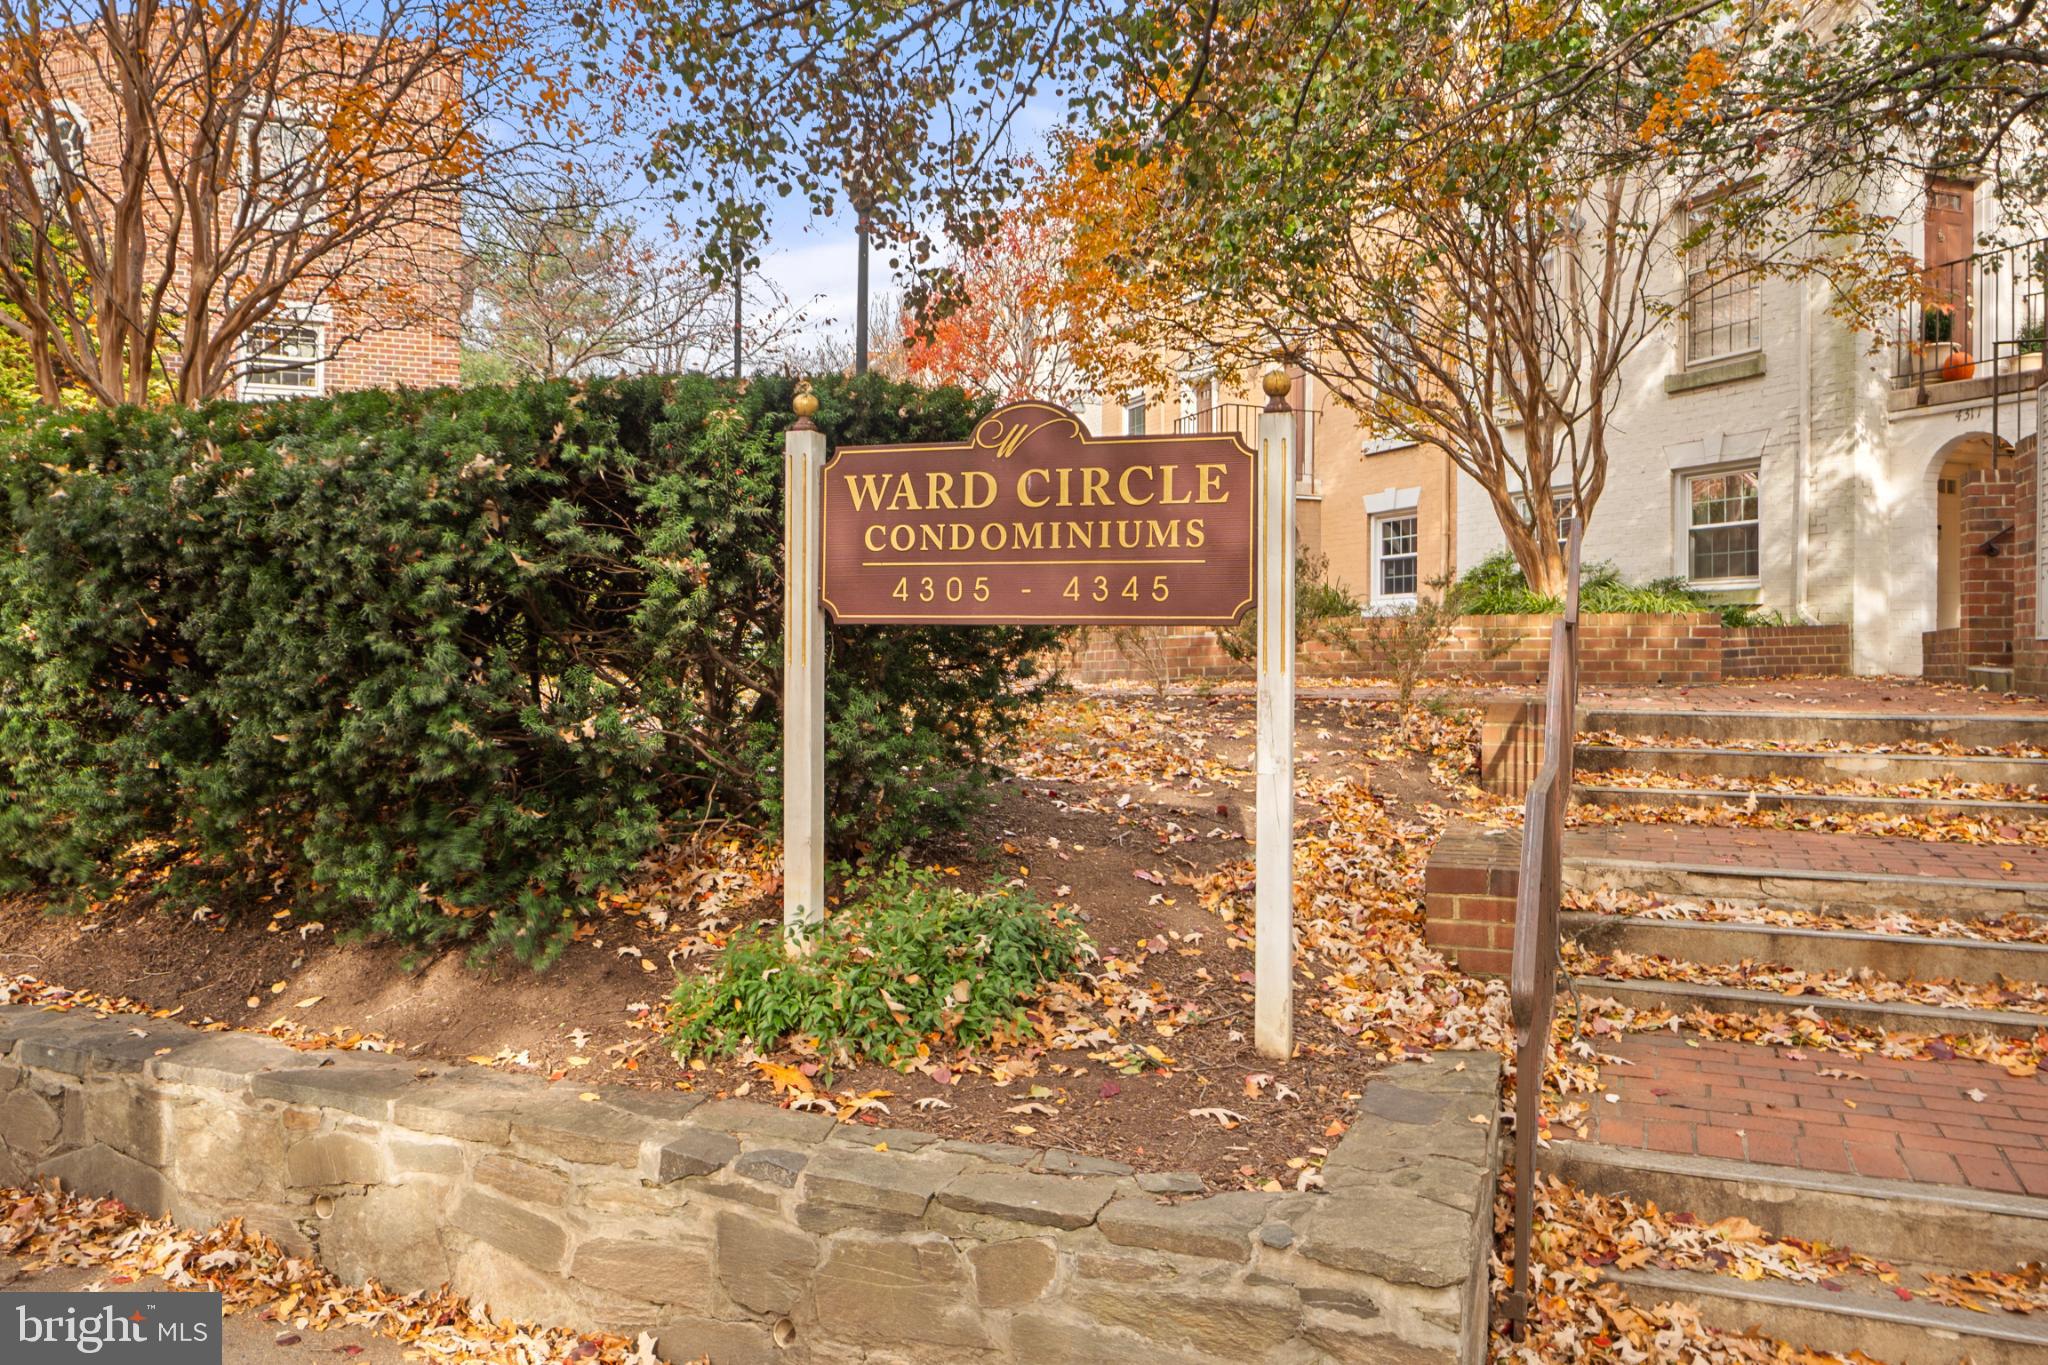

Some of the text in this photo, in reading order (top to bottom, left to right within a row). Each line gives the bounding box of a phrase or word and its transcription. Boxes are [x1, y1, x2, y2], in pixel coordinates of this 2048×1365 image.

[844, 463, 1230, 511] WARD CIRCLE
[864, 519, 1205, 552] CONDOMINIUMS
[892, 577, 990, 601] 4305
[1063, 576, 1169, 601] 4345
